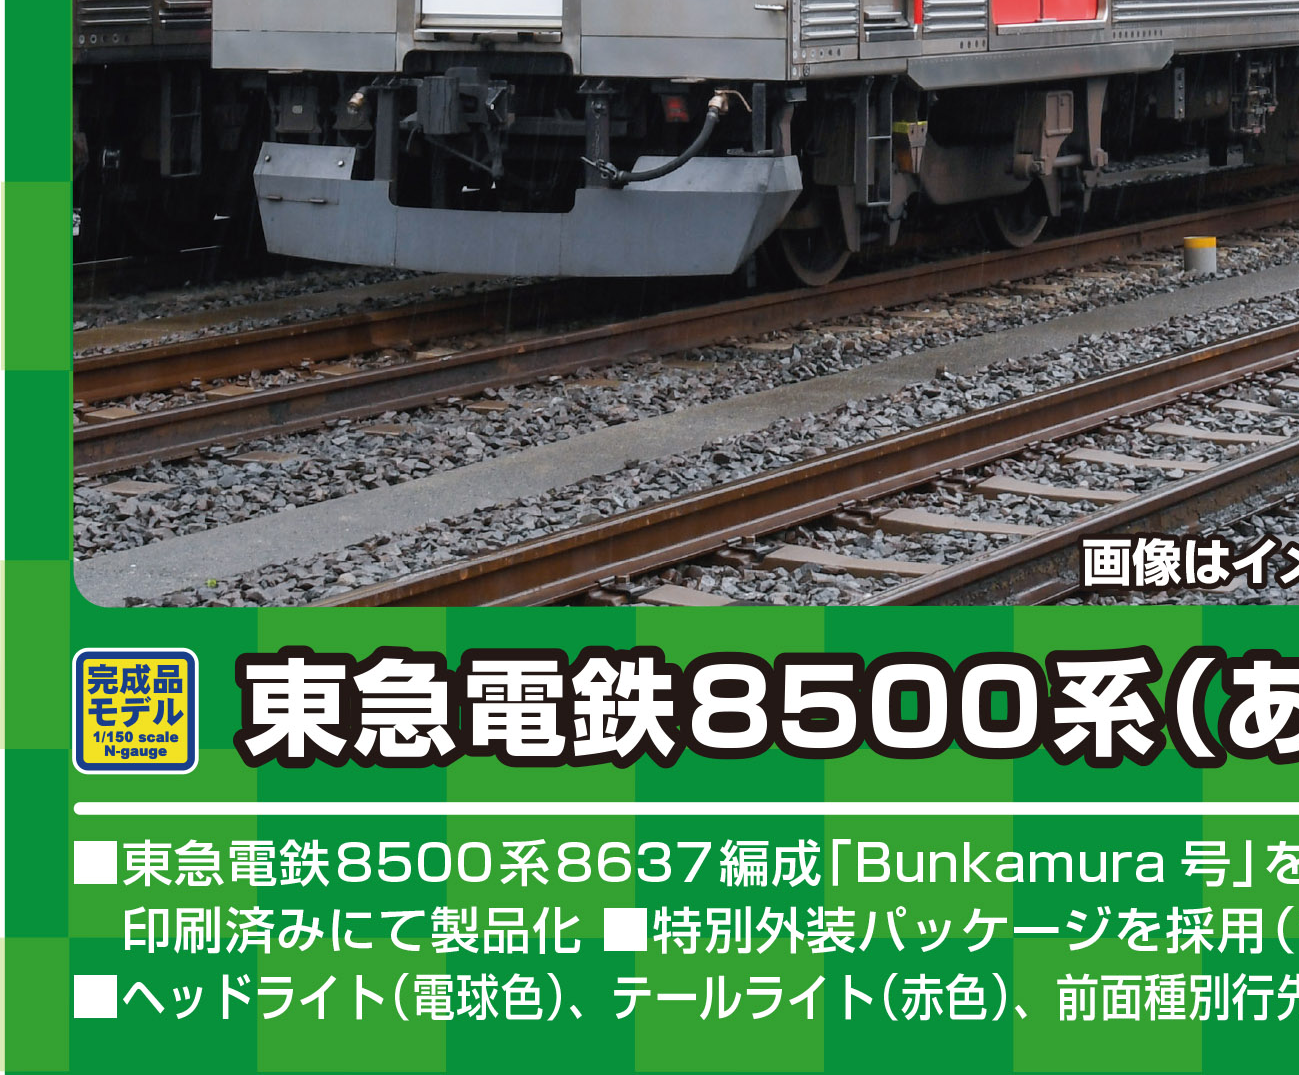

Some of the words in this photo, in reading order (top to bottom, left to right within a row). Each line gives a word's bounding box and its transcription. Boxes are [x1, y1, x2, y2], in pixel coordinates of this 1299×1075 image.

[87, 663, 184, 695] 完成品
[88, 695, 185, 728] モデル
[93, 730, 134, 743] 1/150
[138, 730, 179, 743] scale
[104, 744, 168, 760] N-gauge
